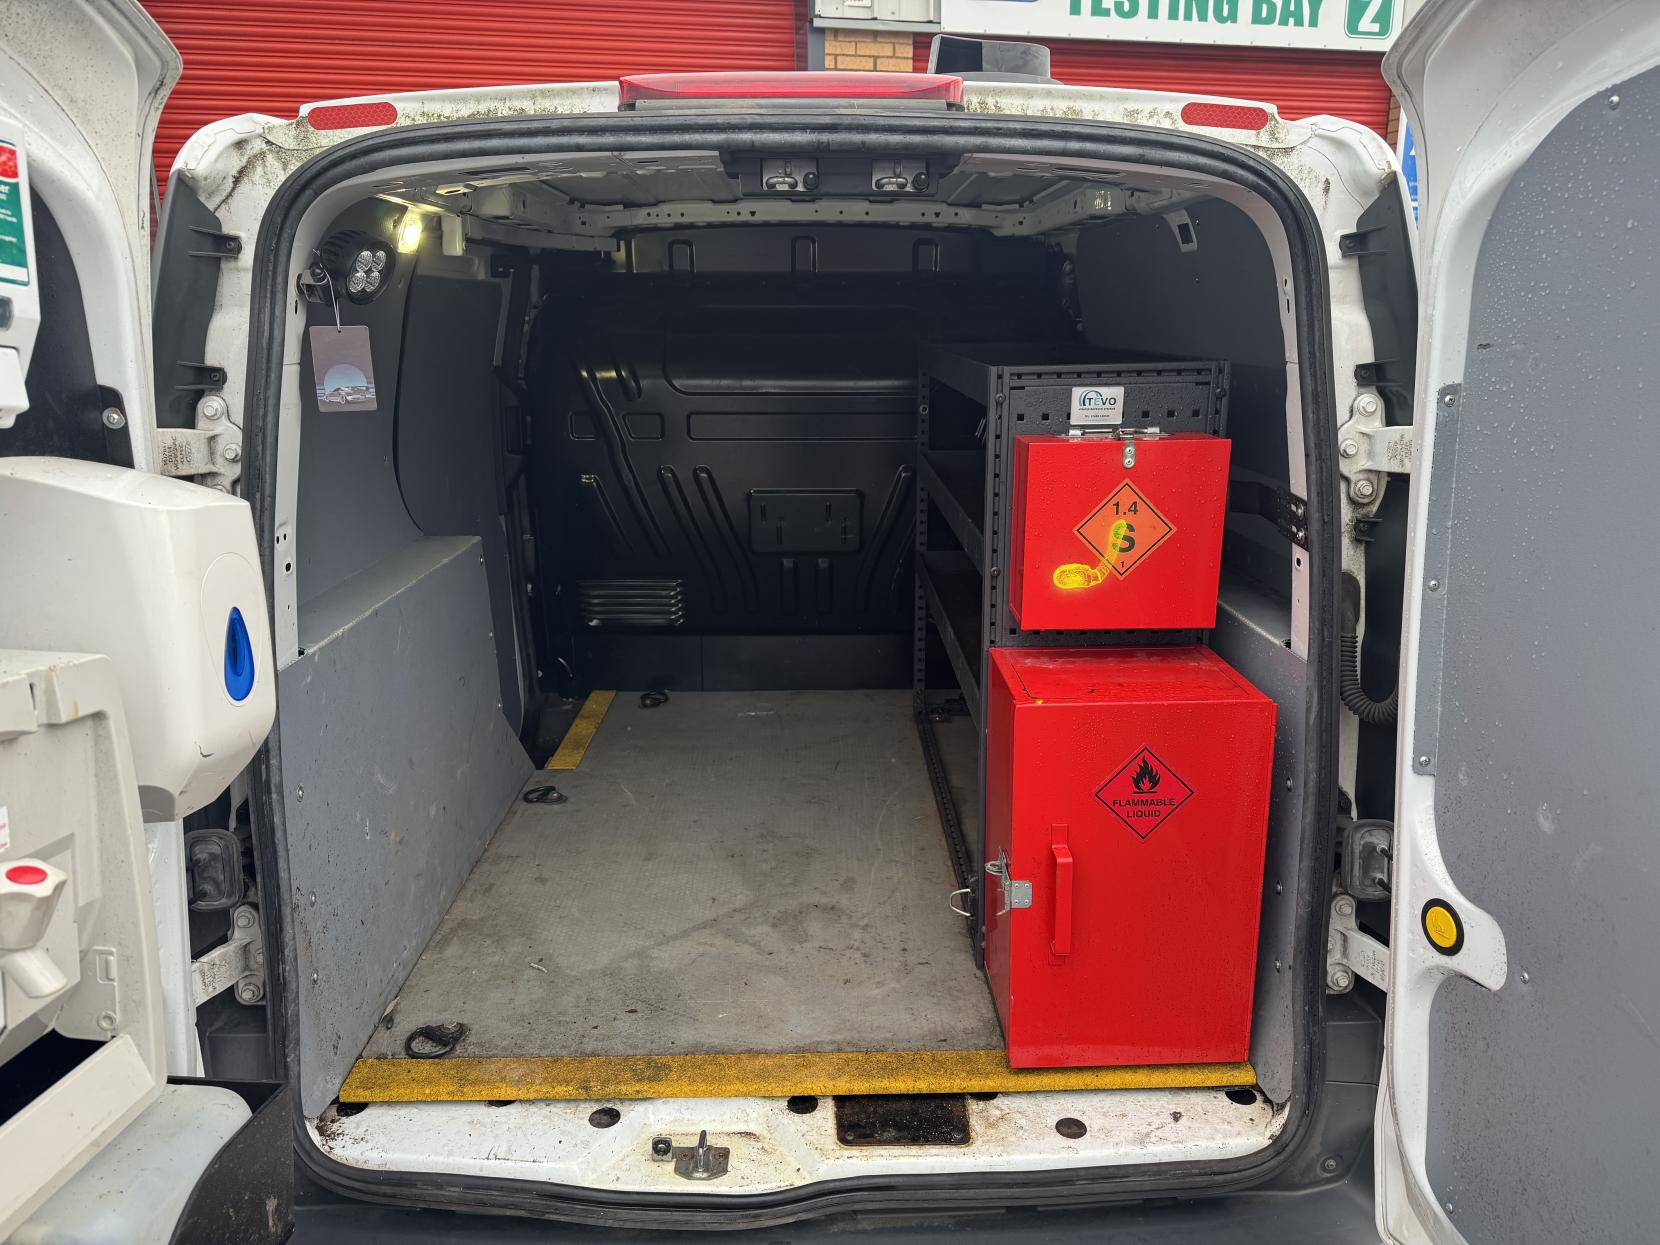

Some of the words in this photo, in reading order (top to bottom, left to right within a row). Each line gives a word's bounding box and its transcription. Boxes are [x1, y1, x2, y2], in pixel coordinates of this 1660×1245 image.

[1357, 0, 1382, 32] 2
[1087, 397, 1117, 406] TEVO
[1113, 501, 1138, 515] 1.4
[1112, 523, 1136, 553] S
[1113, 799, 1176, 807] FLAMMABLE
[1126, 810, 1161, 818] LIQUID
